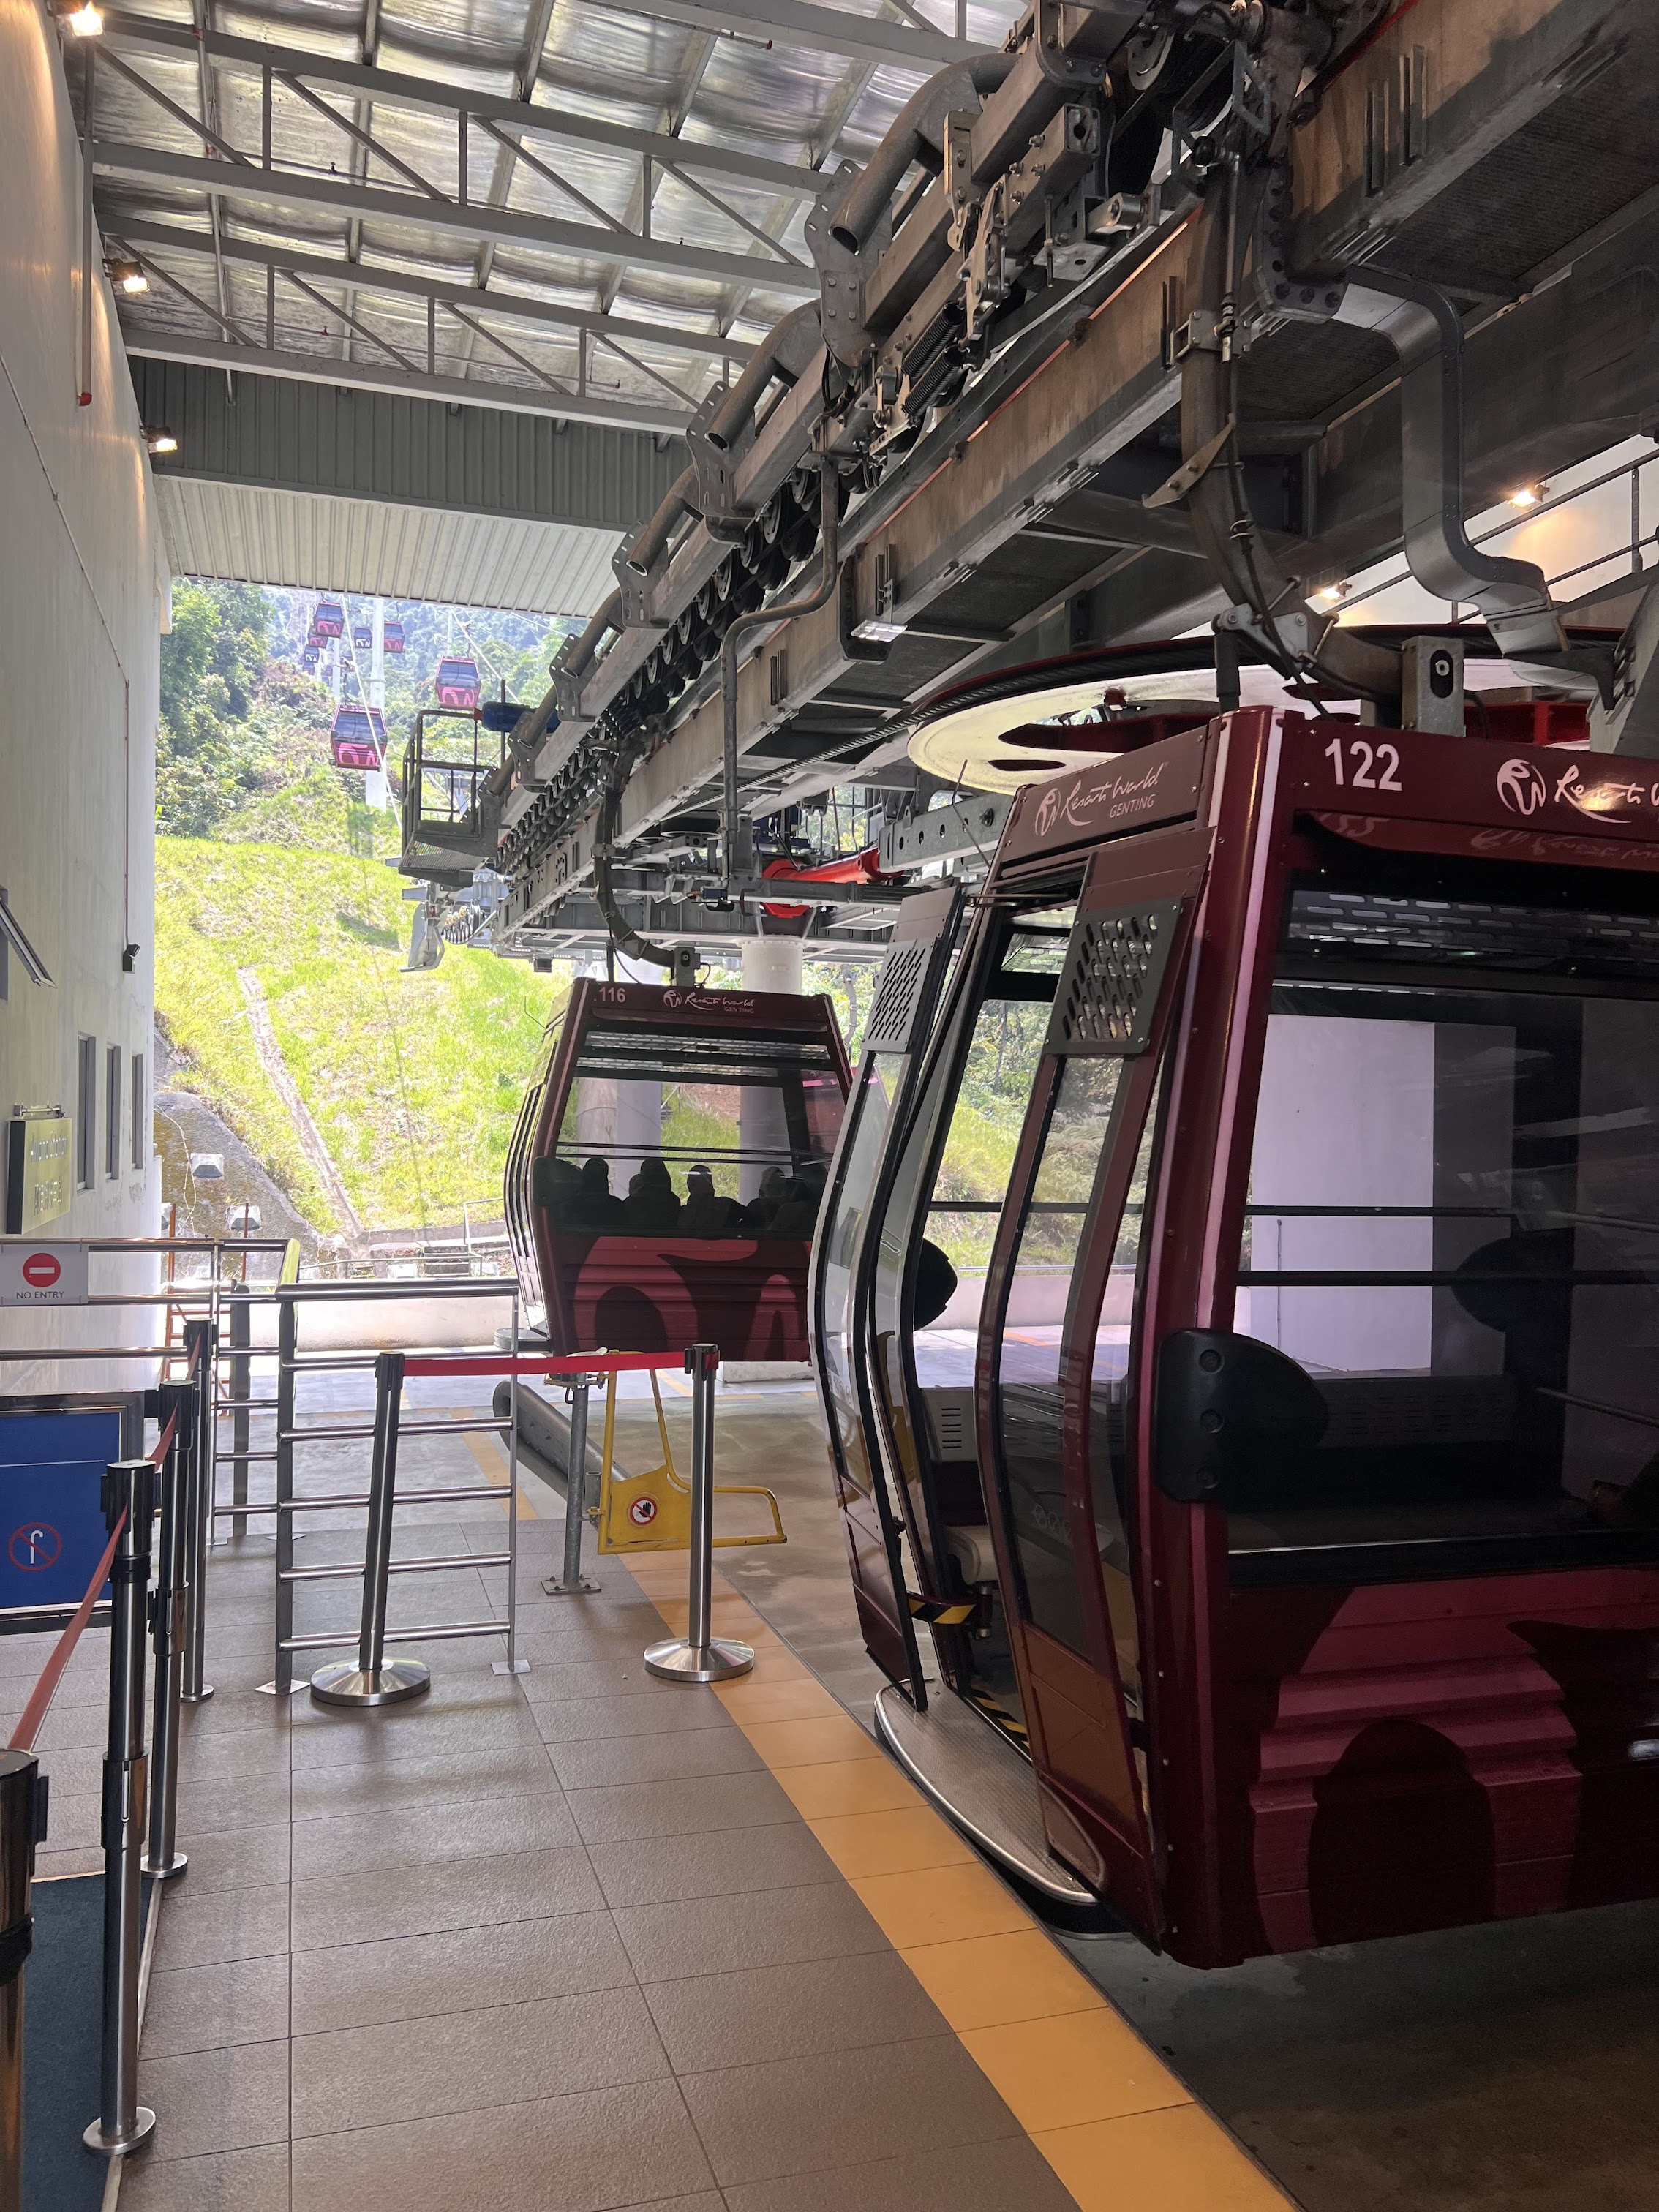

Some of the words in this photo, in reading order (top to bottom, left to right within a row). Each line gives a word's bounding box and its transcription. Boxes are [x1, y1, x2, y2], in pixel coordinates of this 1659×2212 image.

[1325, 738, 1402, 791] 122
[1061, 780, 1112, 827] Resorts
[1112, 763, 1163, 800] World
[1109, 794, 1154, 819] GENTING
[599, 986, 626, 1003] 116
[34, 1291, 64, 1299] ENTRY
